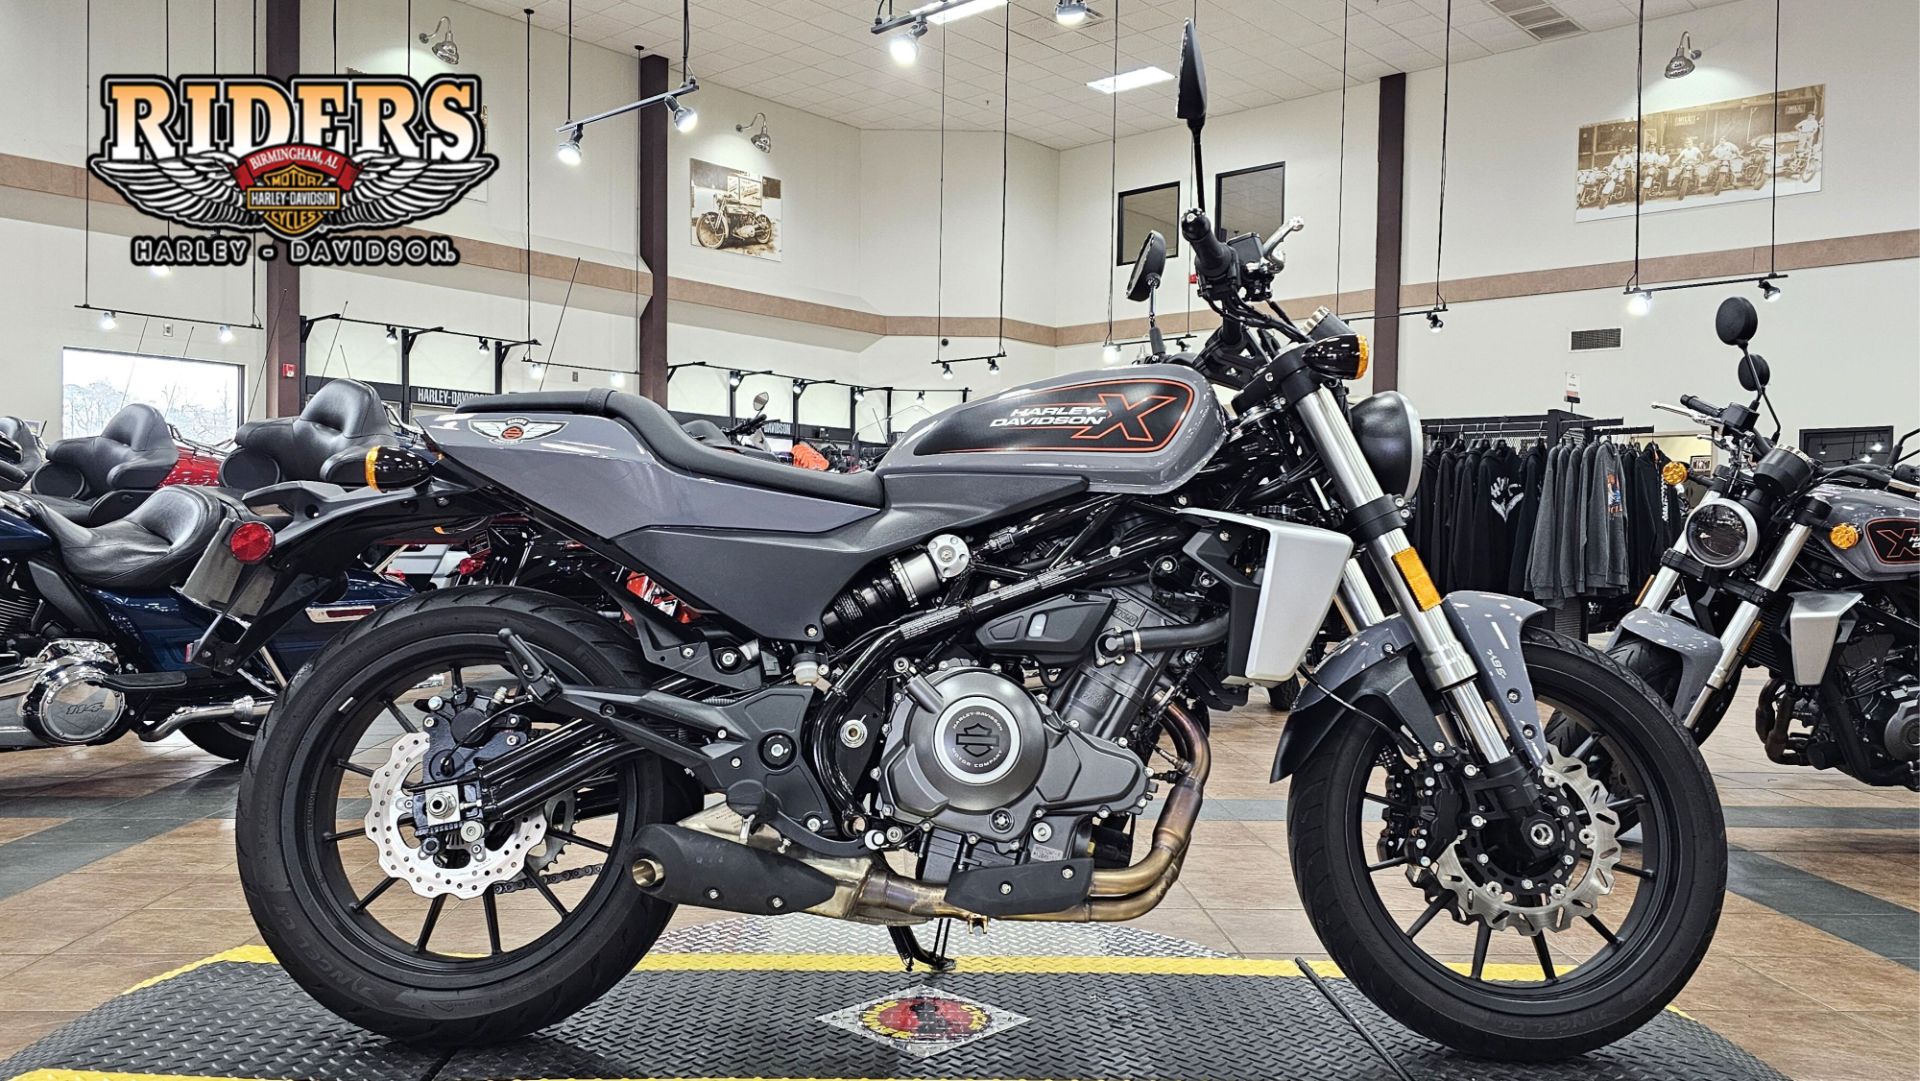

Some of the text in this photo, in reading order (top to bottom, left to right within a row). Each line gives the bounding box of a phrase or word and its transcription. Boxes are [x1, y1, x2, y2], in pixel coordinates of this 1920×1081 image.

[989, 393, 1178, 442] DAVIDSON X
[1009, 406, 1109, 418] HARLEY-
[952, 711, 1003, 732] HARLEY-DAVIDSON
[951, 747, 1003, 768] MOTOR COMPANY
